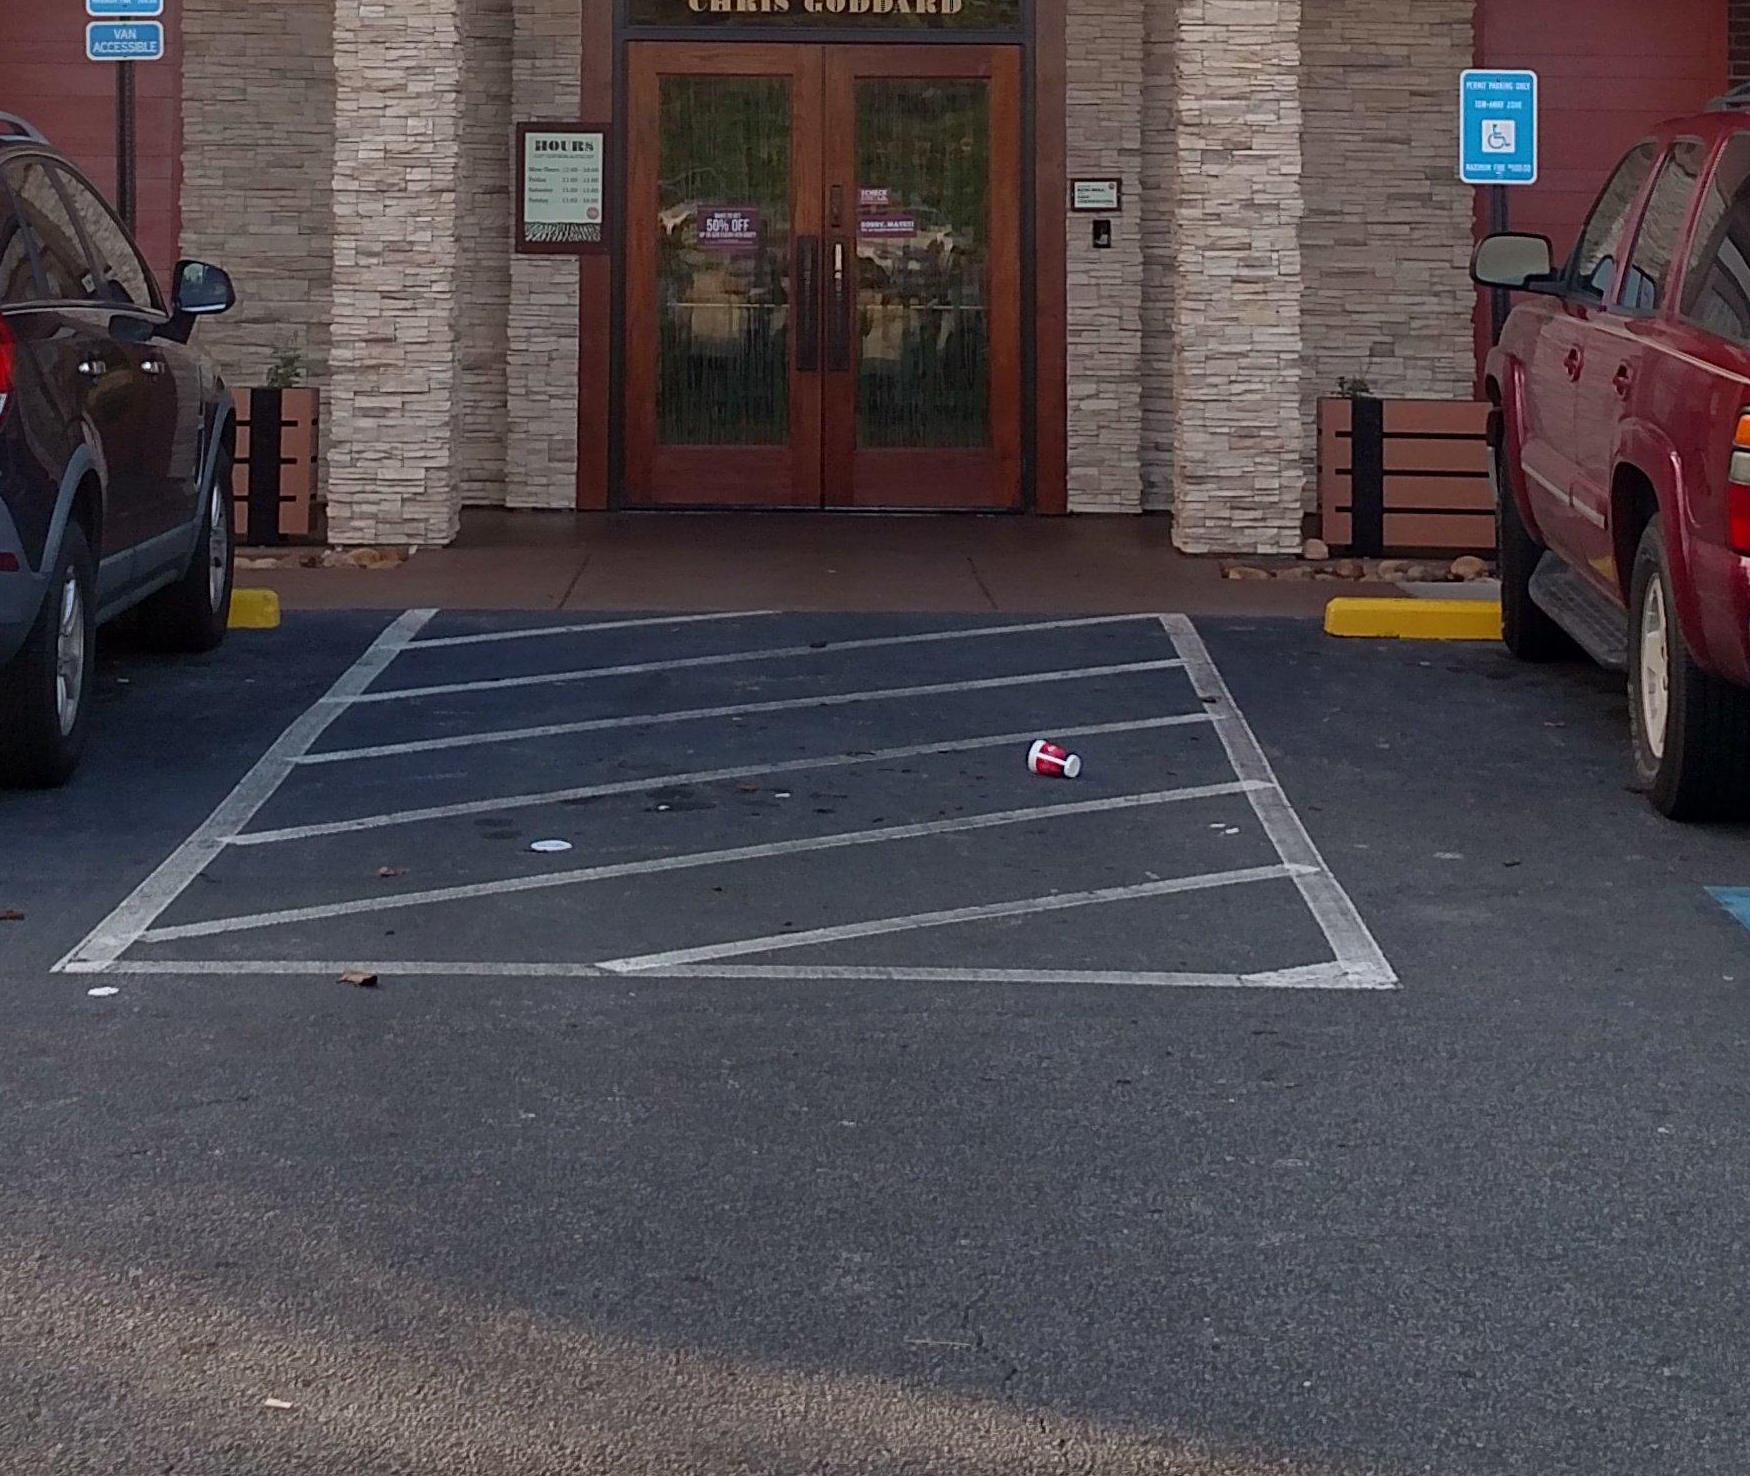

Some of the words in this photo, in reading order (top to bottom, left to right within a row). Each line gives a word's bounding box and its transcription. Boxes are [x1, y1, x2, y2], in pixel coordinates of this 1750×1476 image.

[114, 29, 137, 40] VAN
[92, 41, 158, 53] ACCESSIBLE
[534, 140, 594, 152] HOURS
[706, 219, 729, 232] 50%
[731, 219, 749, 232] OFF
